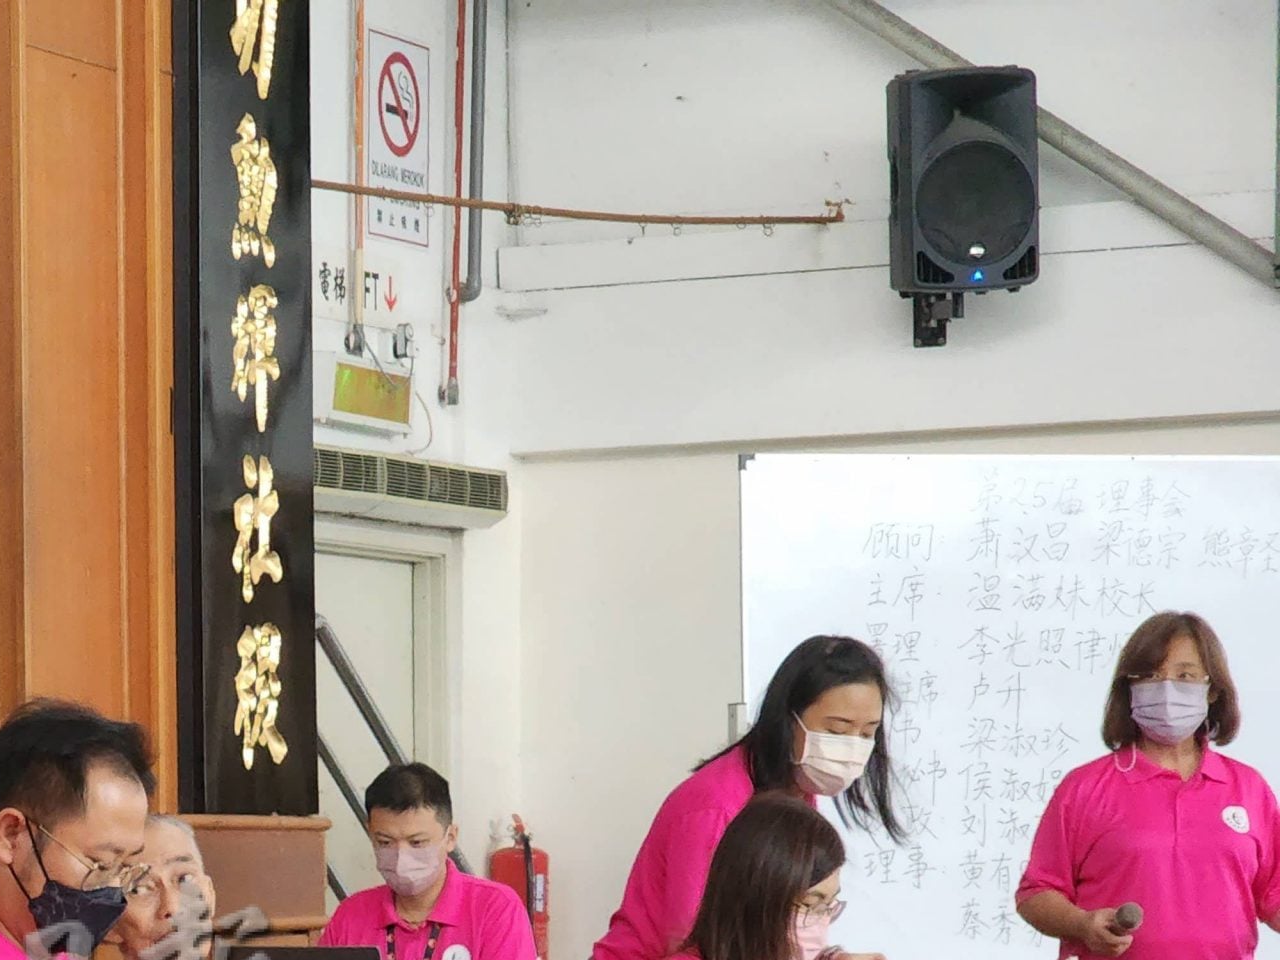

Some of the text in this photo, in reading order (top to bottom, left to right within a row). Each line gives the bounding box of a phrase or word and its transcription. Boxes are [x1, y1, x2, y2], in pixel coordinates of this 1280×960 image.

[1096, 476, 1192, 521] 理事会
[960, 803, 1043, 848] 刘淑
[959, 848, 1028, 894] 黄有
